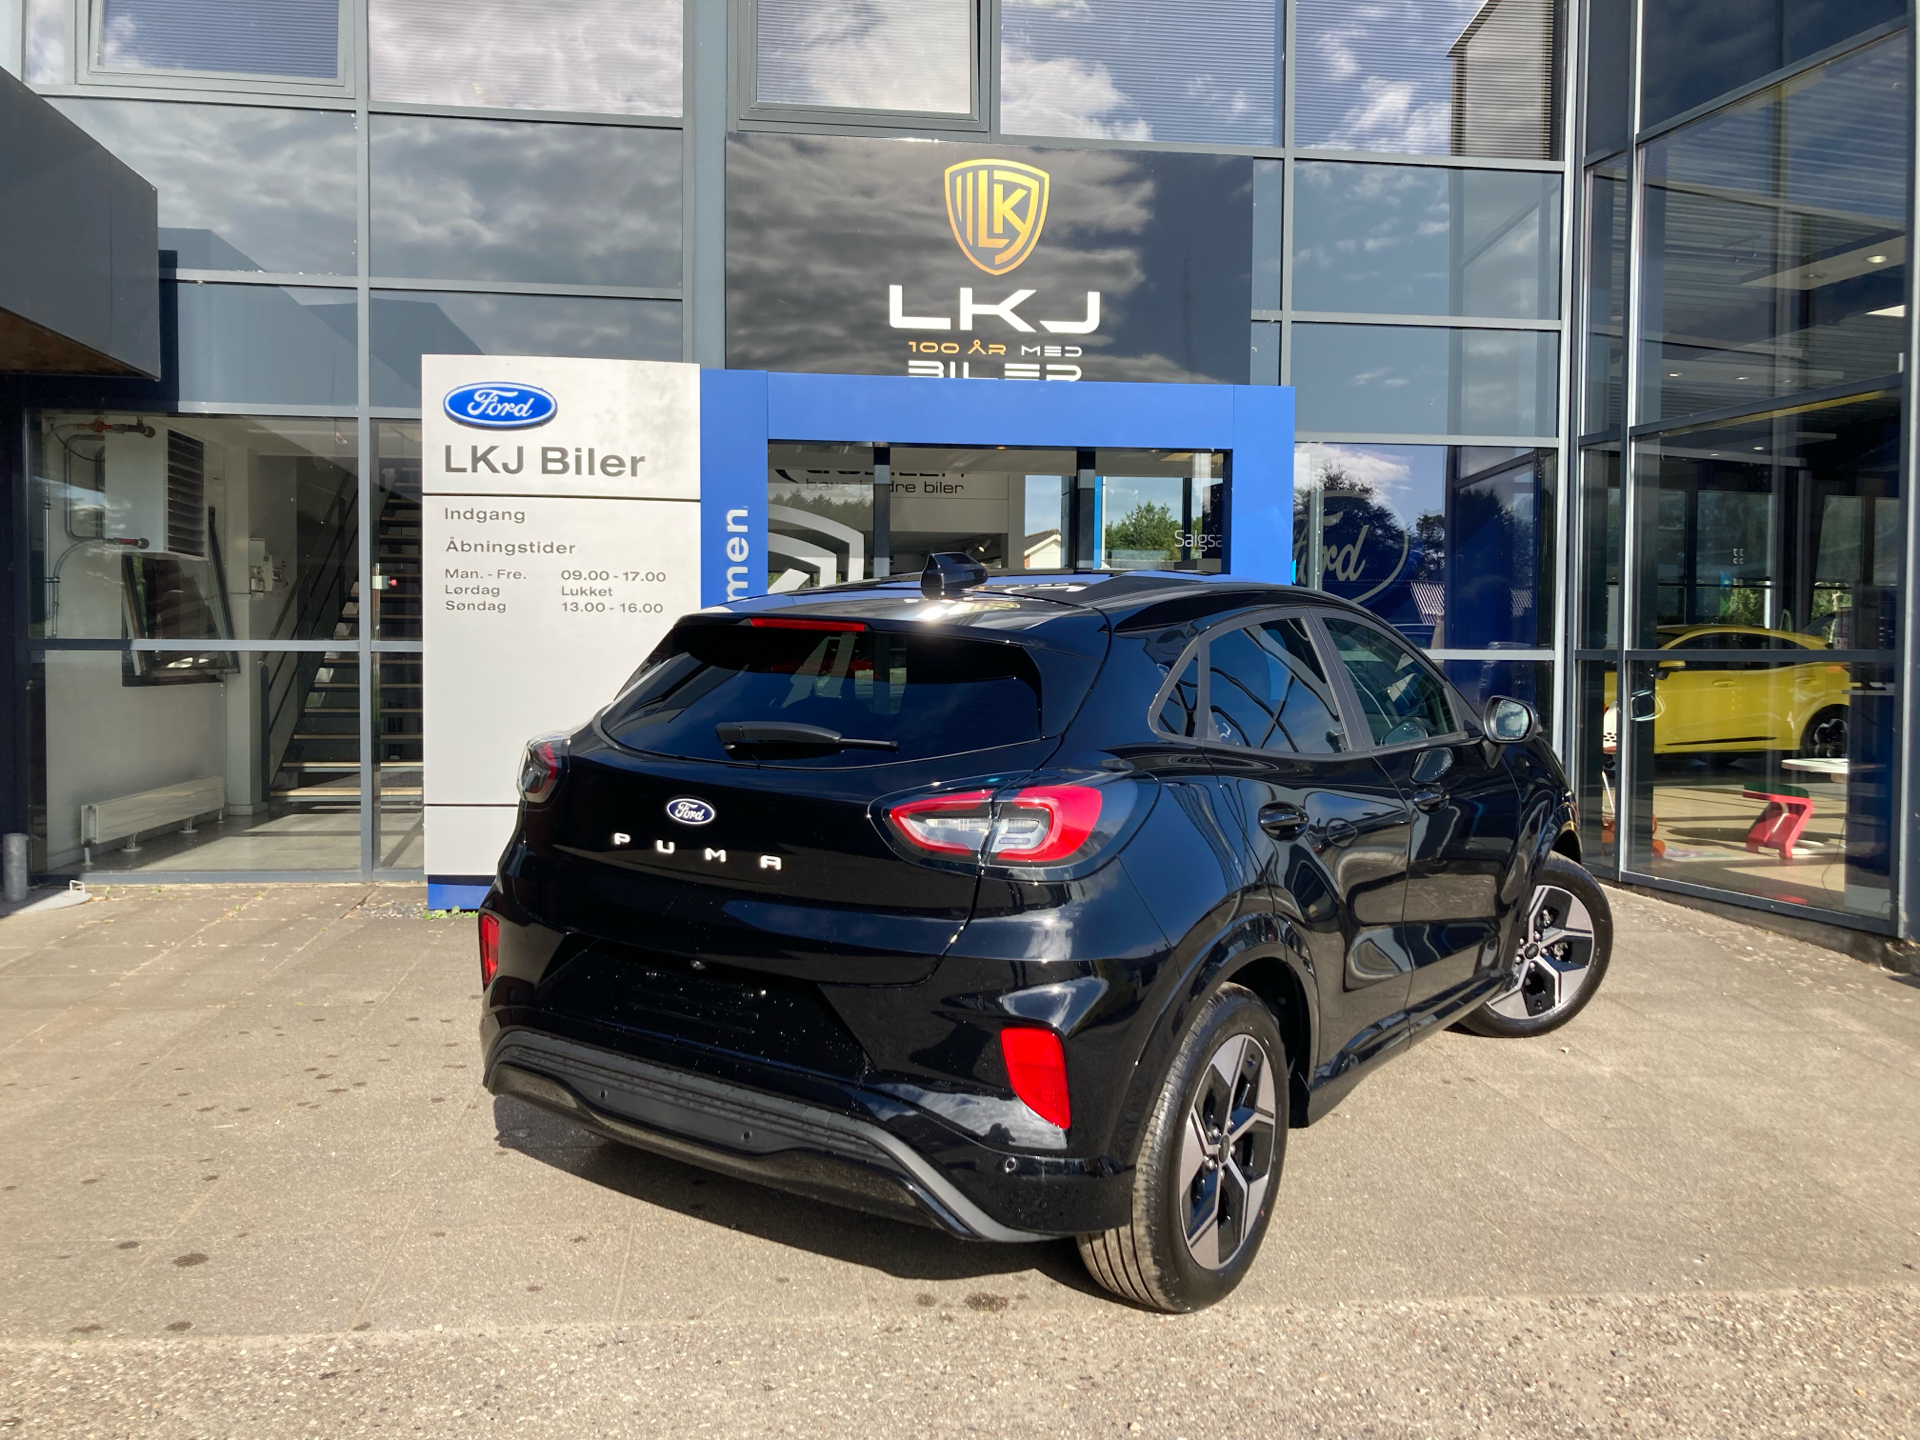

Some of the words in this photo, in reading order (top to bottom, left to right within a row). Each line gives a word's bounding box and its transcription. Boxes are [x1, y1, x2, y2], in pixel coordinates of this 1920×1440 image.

[889, 284, 1101, 335] LKJ
[908, 341, 960, 354] 100
[967, 339, 1007, 355] ÅR
[1021, 345, 1083, 357] MED
[467, 388, 535, 418] Ford
[444, 444, 524, 475] LKJ
[541, 446, 646, 478] Biler
[924, 481, 965, 494] biler
[444, 507, 526, 523] Indgang
[445, 536, 576, 556] Åbningstider
[444, 568, 484, 580] Man.
[496, 569, 527, 580] Fre.
[560, 569, 610, 581] 09.00
[622, 571, 667, 582] 17.00
[444, 584, 501, 598] Lørdag
[561, 586, 614, 597] Lukket
[445, 600, 507, 613] Søndag
[561, 602, 606, 613] 13.00
[619, 603, 664, 614] 16.00
[674, 801, 706, 821] Ford
[613, 832, 782, 870] PUMA
